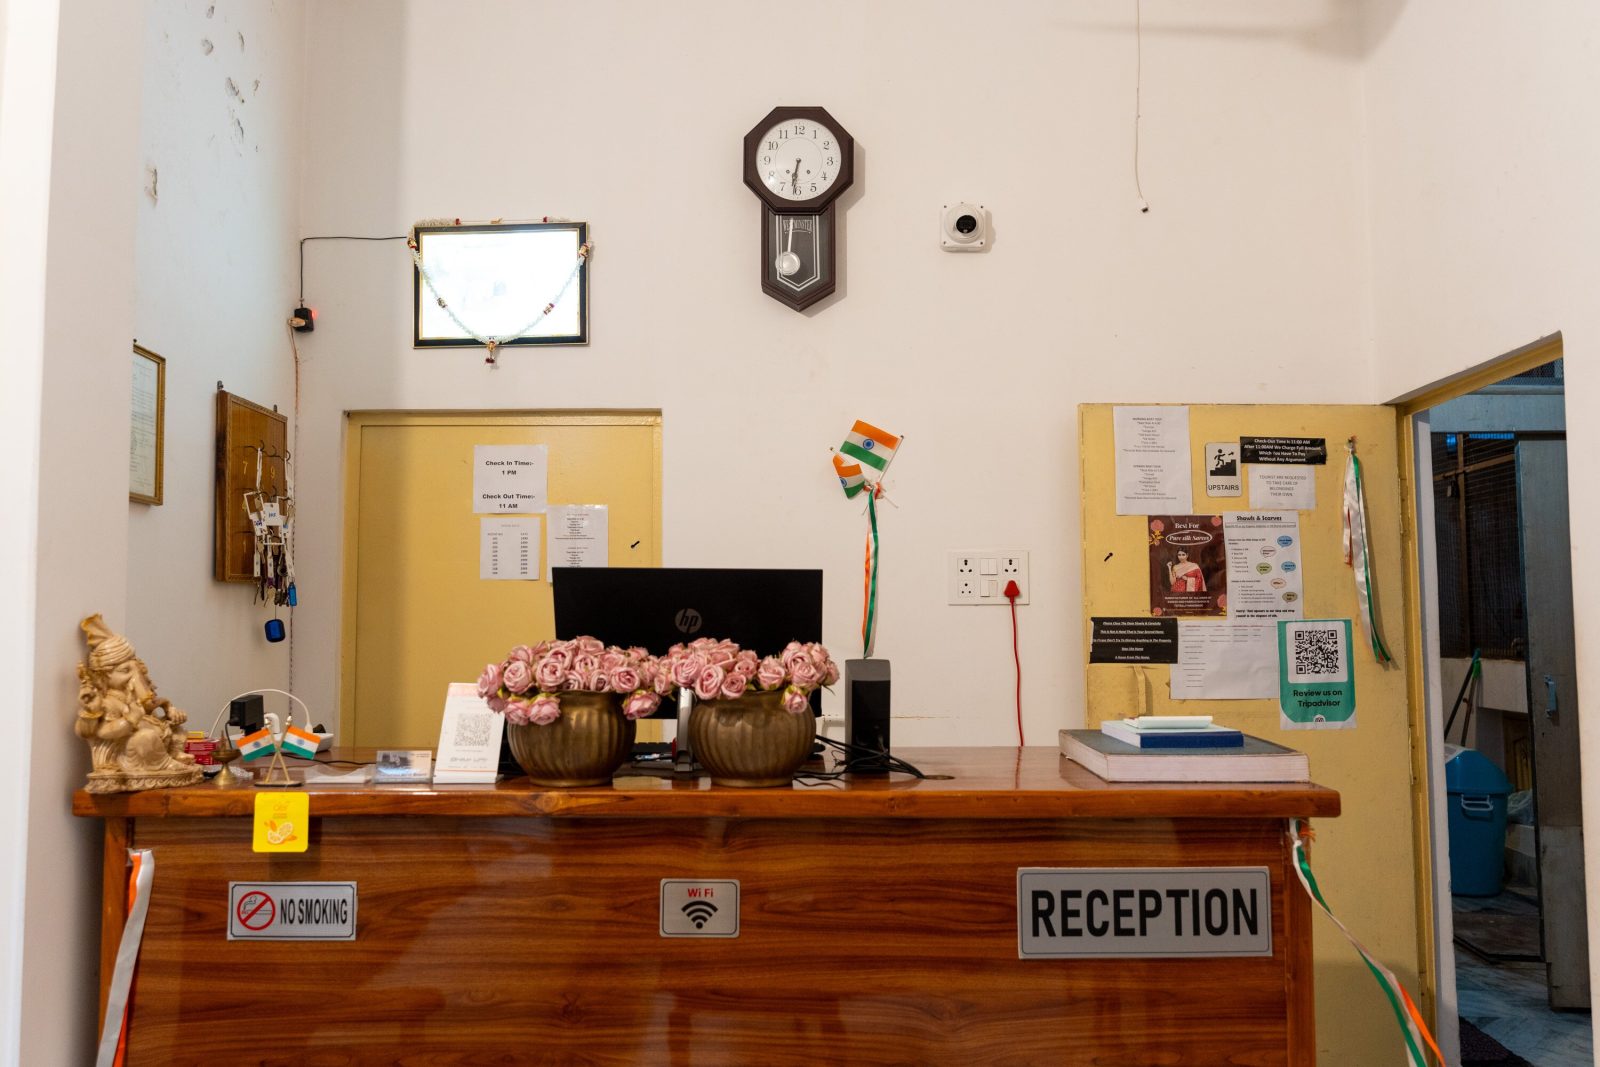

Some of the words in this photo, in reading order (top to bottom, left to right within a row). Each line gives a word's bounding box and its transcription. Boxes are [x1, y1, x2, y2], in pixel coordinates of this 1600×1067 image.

[779, 129, 788, 139] 11
[794, 126, 805, 135] 12
[813, 130, 818, 139] 1
[768, 142, 778, 151] 10
[823, 141, 830, 150] 2
[763, 156, 771, 165] 9
[827, 157, 834, 166] 3
[821, 171, 828, 180] 4
[780, 182, 786, 191] 7
[795, 186, 802, 196] 6
[810, 182, 817, 192] 5
[243, 461, 248, 475] 7
[270, 464, 276, 479] 9
[676, 608, 701, 633] hp
[1293, 689, 1321, 697] Review
[1298, 699, 1340, 709] Tripadvisor
[687, 888, 701, 897] Wi
[704, 888, 714, 897] Fi
[280, 898, 296, 924] NO
[298, 898, 348, 924] SMOKING
[1031, 888, 1258, 938] RECEPTION
